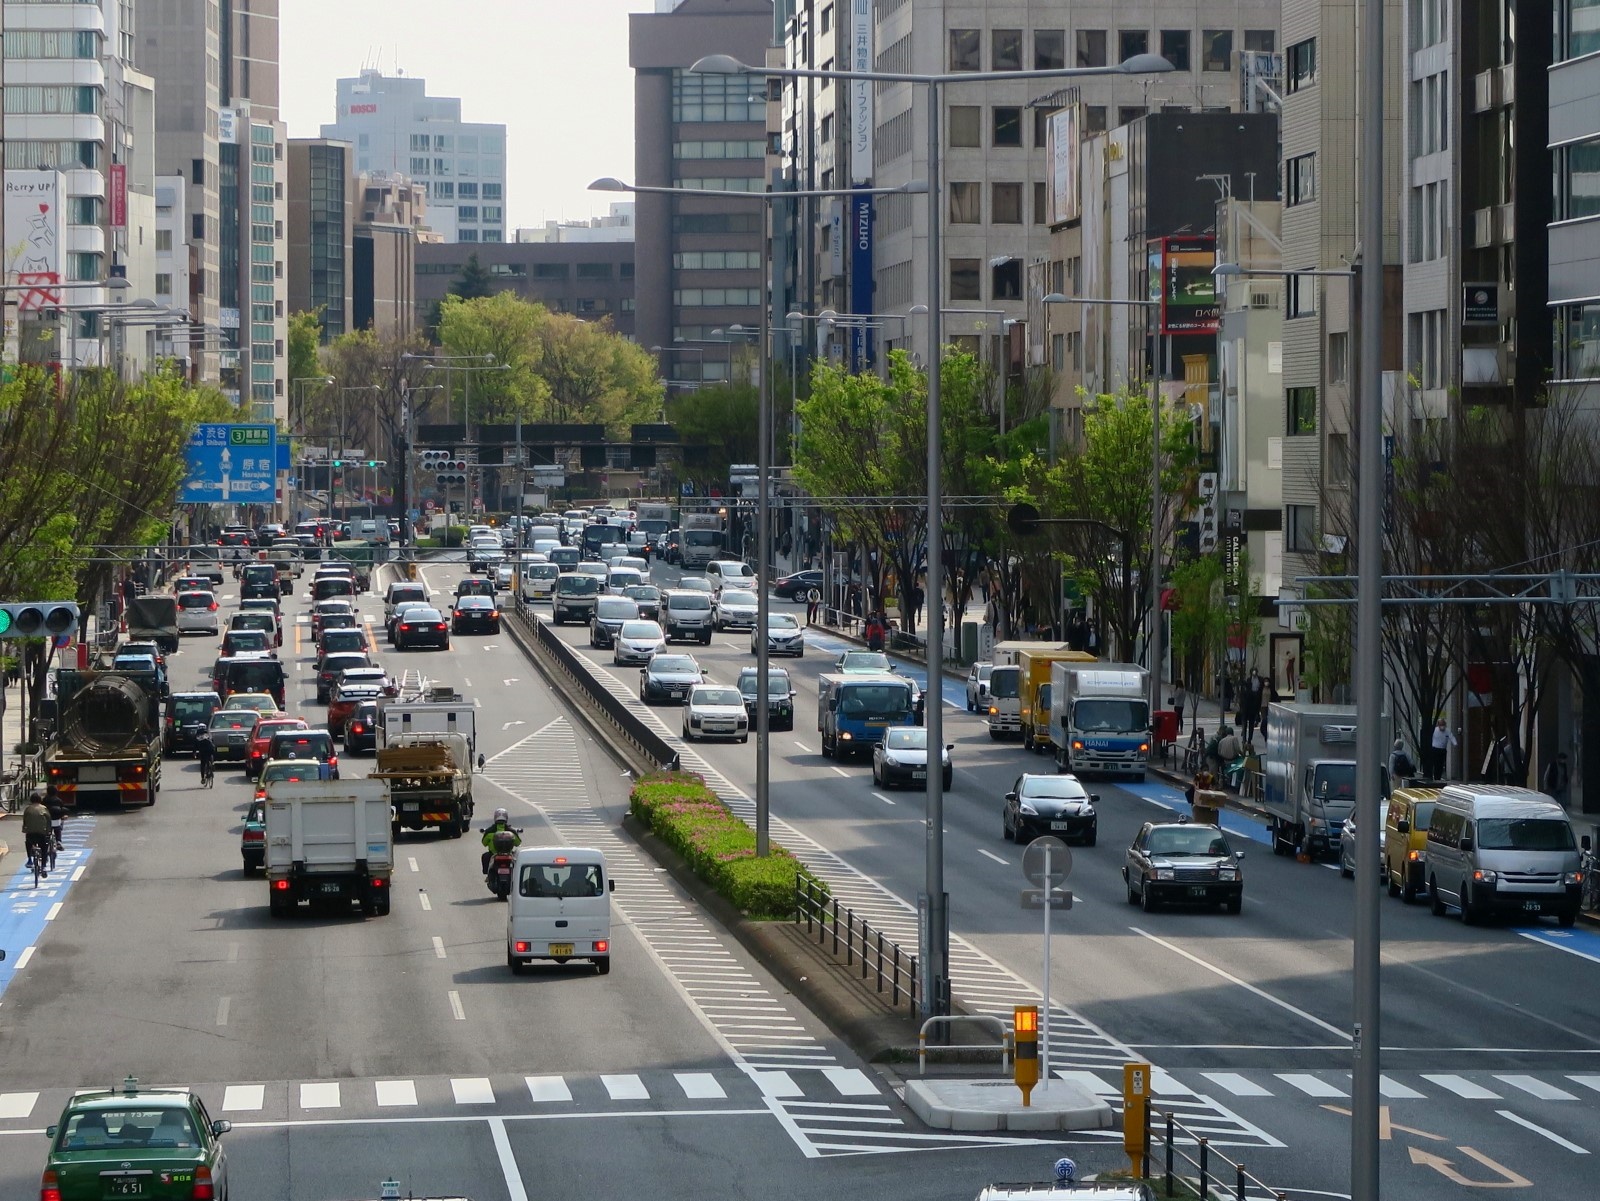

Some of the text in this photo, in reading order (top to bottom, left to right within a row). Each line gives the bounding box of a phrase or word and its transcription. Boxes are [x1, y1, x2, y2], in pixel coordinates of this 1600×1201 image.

[350, 104, 377, 114] BOSCH
[6, 182, 34, 193] Berry
[859, 202, 869, 250] MIZUHO
[206, 427, 226, 439] 渋谷
[235, 432, 241, 440] 3
[243, 459, 271, 471] 原宿
[1085, 740, 1109, 748] HANAI
